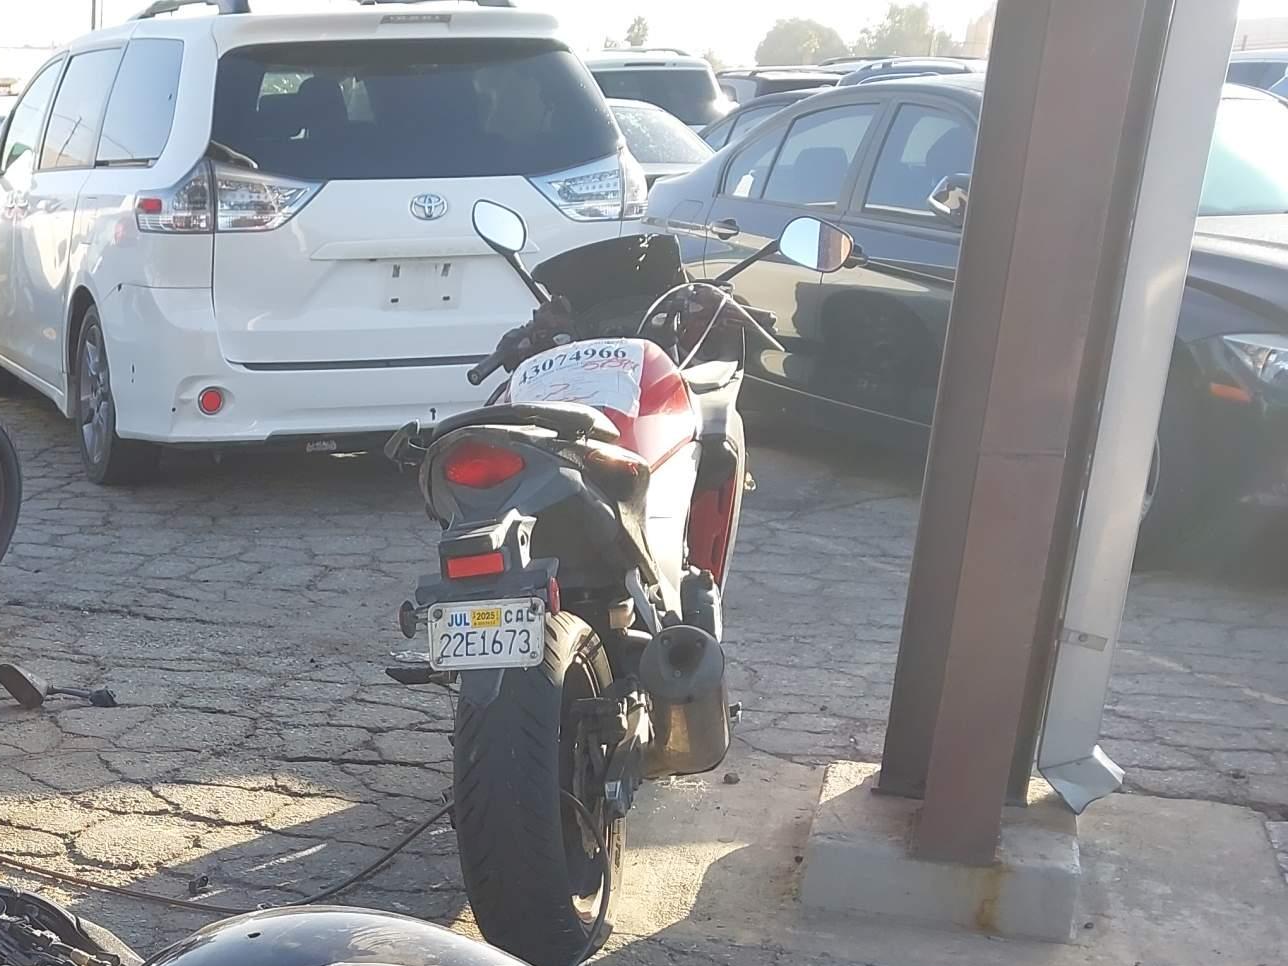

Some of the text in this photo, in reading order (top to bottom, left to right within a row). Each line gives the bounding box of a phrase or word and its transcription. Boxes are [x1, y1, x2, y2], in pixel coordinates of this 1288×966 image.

[447, 609, 535, 627] JUL 2025 CAL
[439, 628, 531, 658] 22E1673
